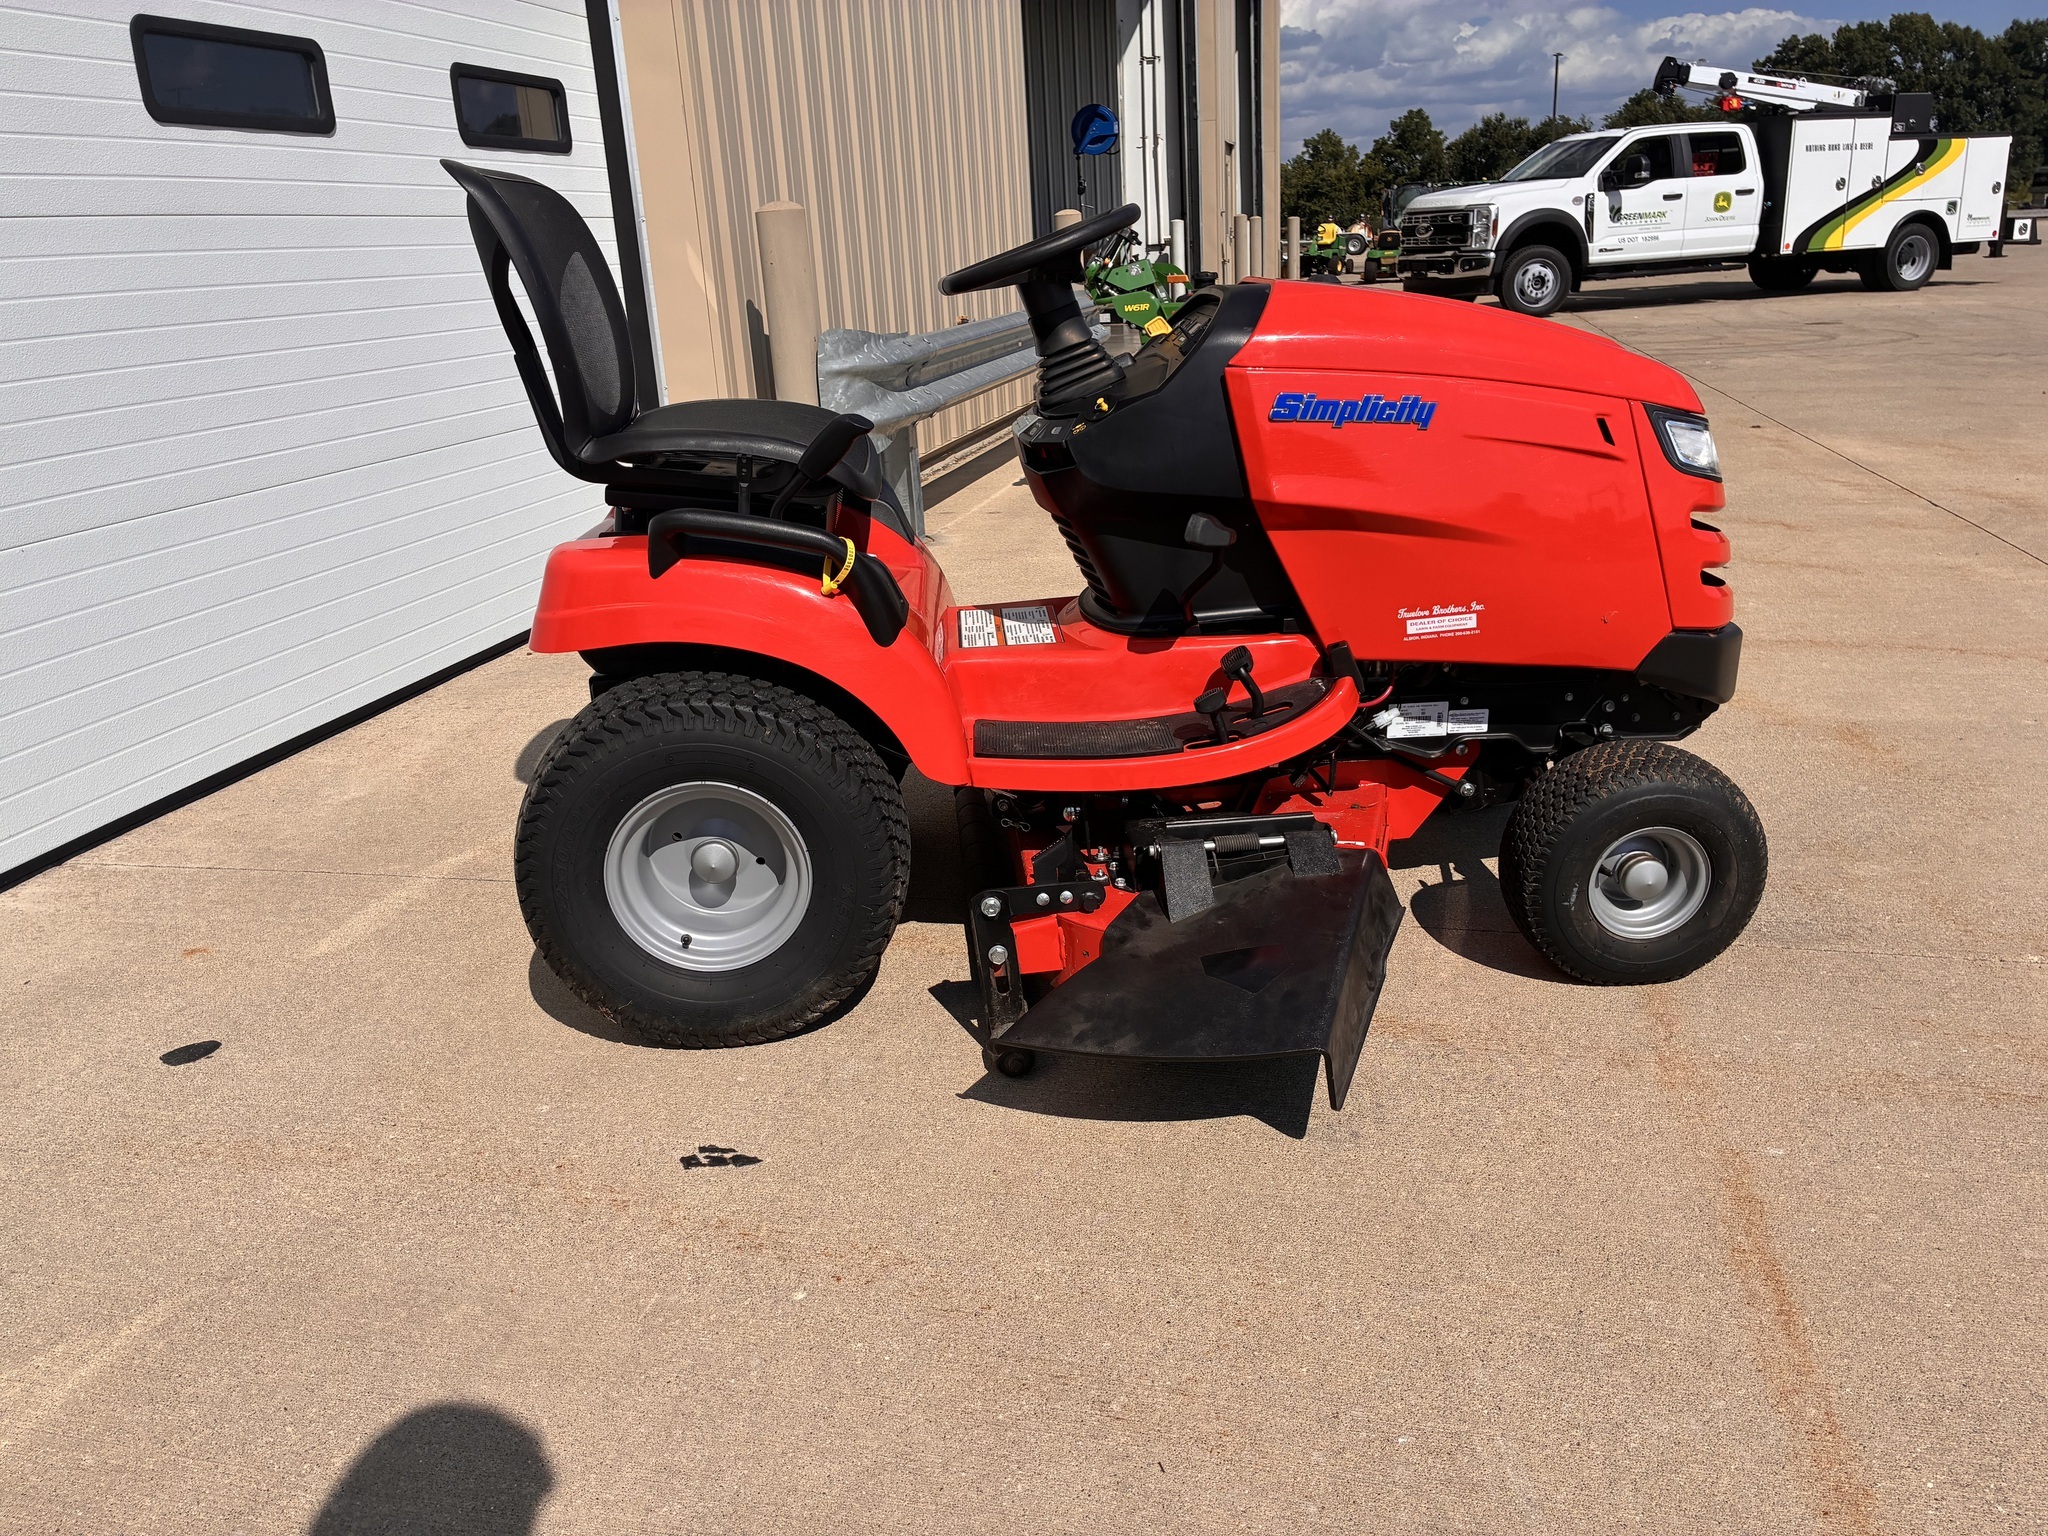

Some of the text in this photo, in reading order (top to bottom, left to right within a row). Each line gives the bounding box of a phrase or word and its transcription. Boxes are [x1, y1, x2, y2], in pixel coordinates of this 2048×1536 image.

[1124, 303, 1150, 312] W61R
[1268, 391, 1438, 431] Simplicity
[1397, 606, 1430, 618] Truelove
[1470, 600, 1485, 611] Inc.
